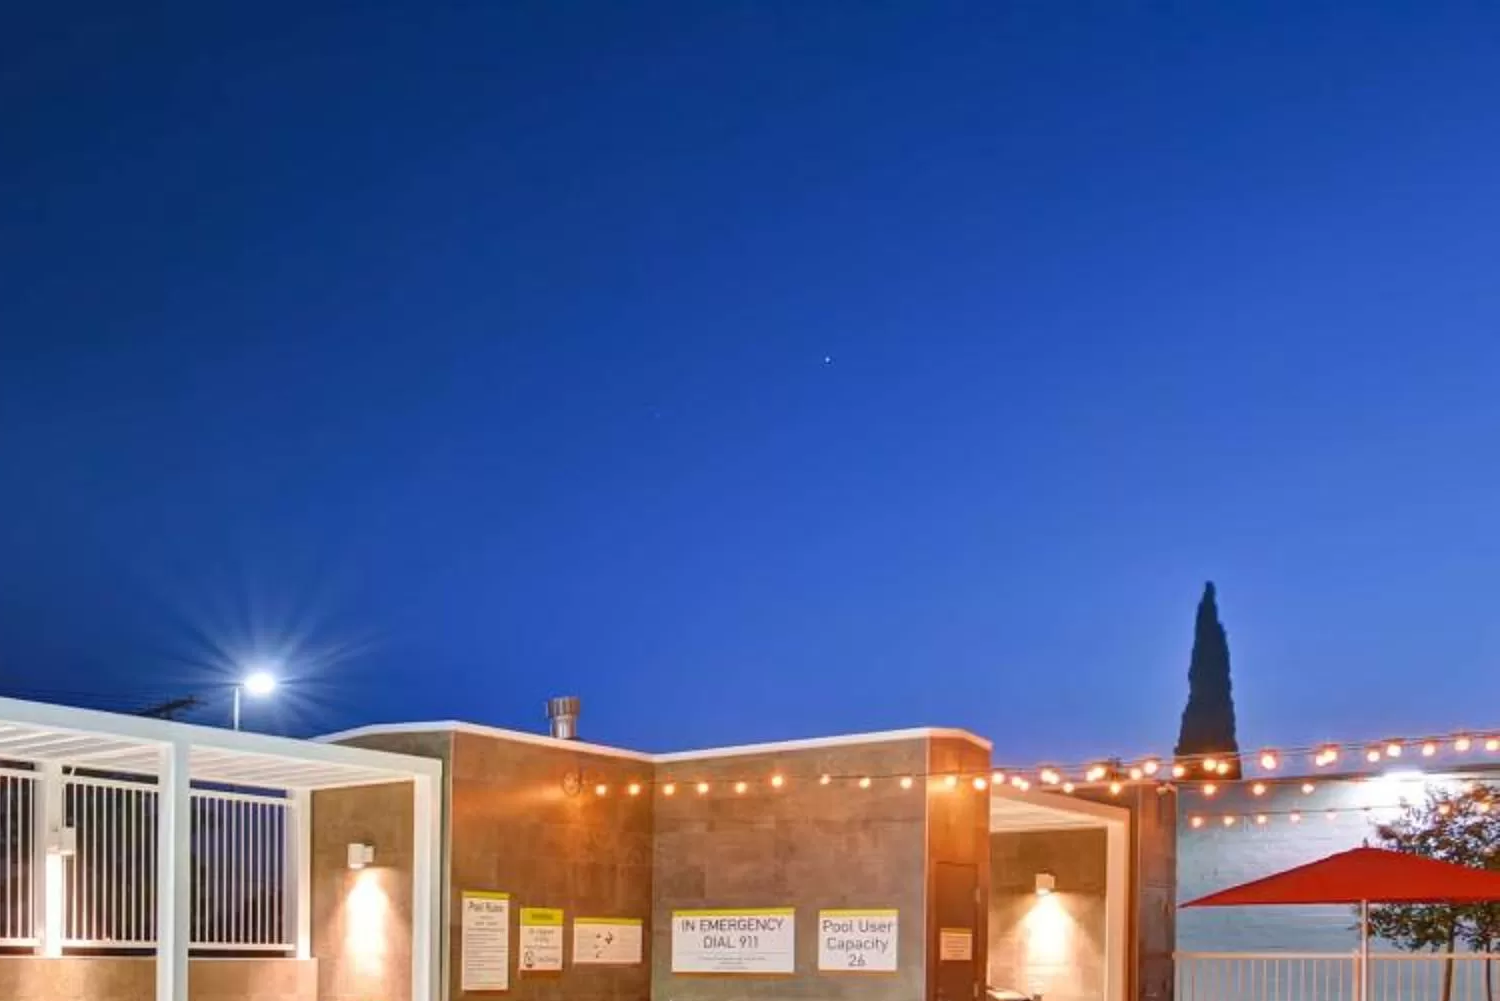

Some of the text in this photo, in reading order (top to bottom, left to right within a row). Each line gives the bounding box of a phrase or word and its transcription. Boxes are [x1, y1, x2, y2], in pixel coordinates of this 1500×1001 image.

[681, 917, 784, 932] IN EMERGENCY
[822, 919, 893, 933] Pool User
[703, 935, 759, 949] DIAL 911
[826, 936, 889, 954] Capacity
[847, 953, 866, 967] 26
